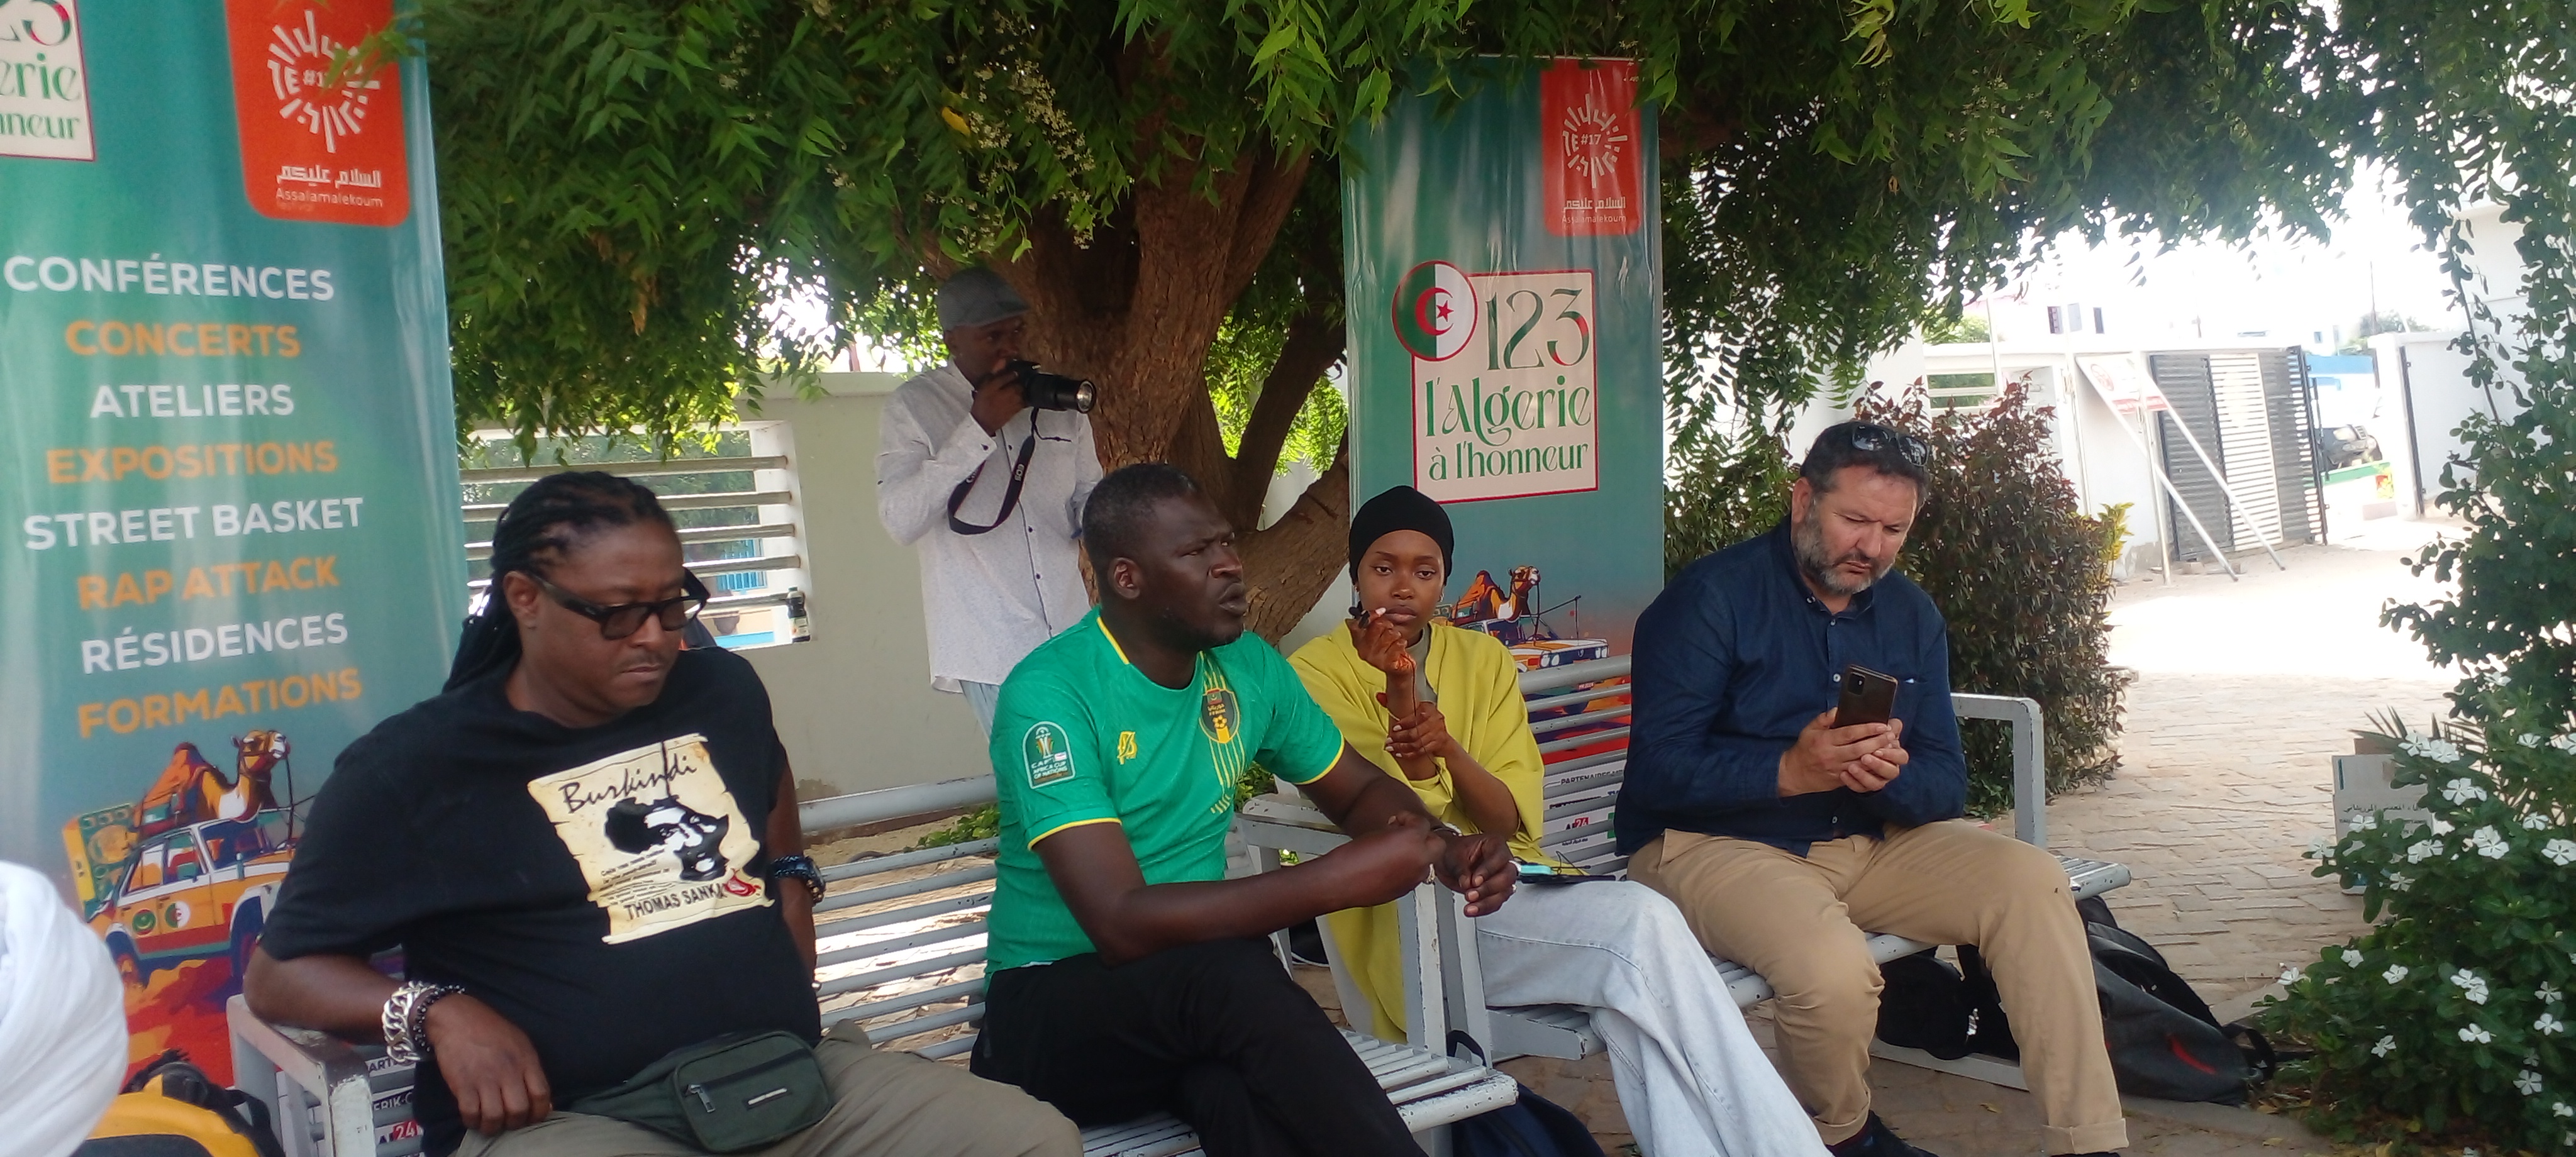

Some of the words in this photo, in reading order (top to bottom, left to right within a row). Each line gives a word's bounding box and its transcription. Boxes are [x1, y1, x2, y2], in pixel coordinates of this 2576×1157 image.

[1580, 134, 1601, 145] #17
[277, 164, 331, 187] عليكم
[335, 168, 381, 189] السلام
[275, 187, 383, 208] Assalamalekoum
[1563, 197, 1592, 213] عليكم
[1595, 196, 1626, 213] السلام
[3, 253, 334, 301] CONFÉRENCES
[65, 321, 301, 358] CONCERTS
[1485, 288, 1590, 370] 123
[90, 384, 294, 418] ATELIERS
[1425, 375, 1591, 446] l'Algerie
[47, 441, 338, 484] EXPOSITIONS
[1429, 446, 1446, 480] à
[1457, 441, 1589, 479] l'honneur
[24, 507, 200, 550] STREET
[212, 497, 363, 536] BASKET
[78, 570, 172, 611] RAP
[182, 556, 340, 600] ATTACK
[82, 613, 348, 675] RÉSIDENCES
[78, 668, 362, 738] FORMATIONS
[623, 893, 680, 920] THOMAS
